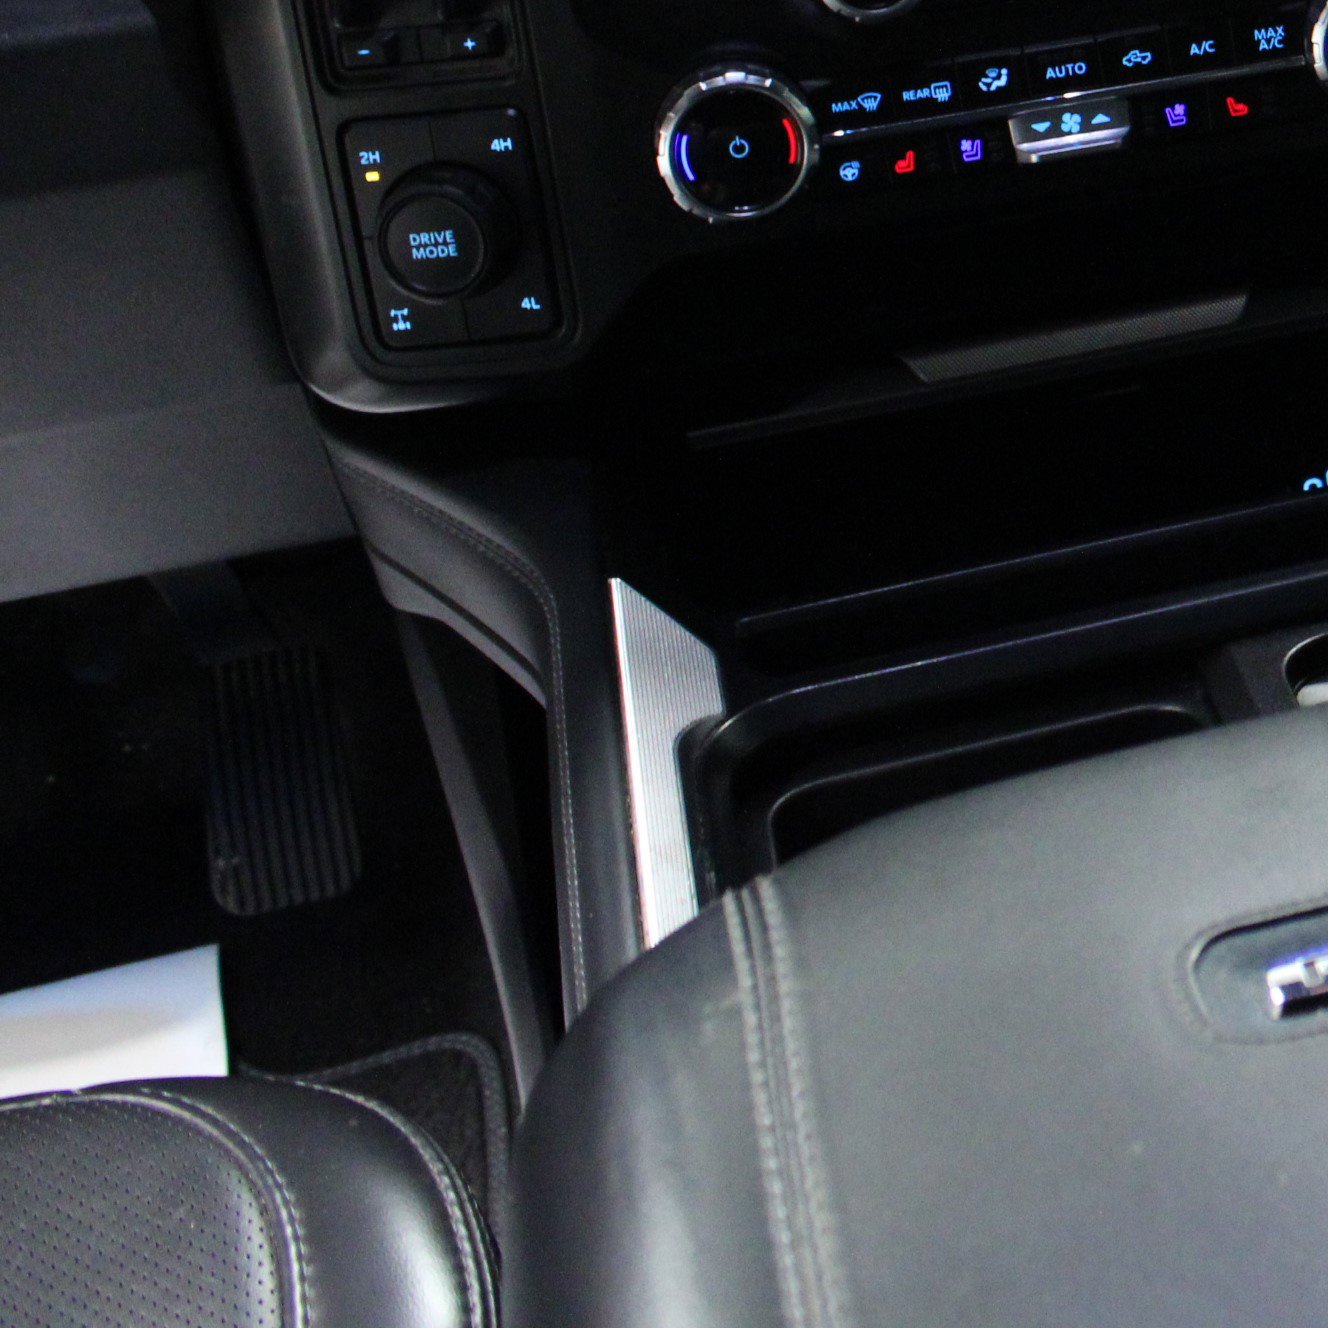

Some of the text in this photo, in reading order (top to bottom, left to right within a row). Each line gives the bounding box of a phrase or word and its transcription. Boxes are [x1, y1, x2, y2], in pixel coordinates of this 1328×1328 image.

[1253, 25, 1285, 40] MAX
[1190, 40, 1215, 56] A/C
[1259, 36, 1284, 51] A/C
[1046, 61, 1086, 79] AUTO
[902, 87, 930, 101] REAR
[831, 99, 858, 112] MAX
[490, 137, 512, 152] 4H
[359, 150, 380, 165] 2H
[409, 229, 455, 246] DRIVE
[412, 243, 458, 259] MODE
[521, 296, 540, 310] 4L
